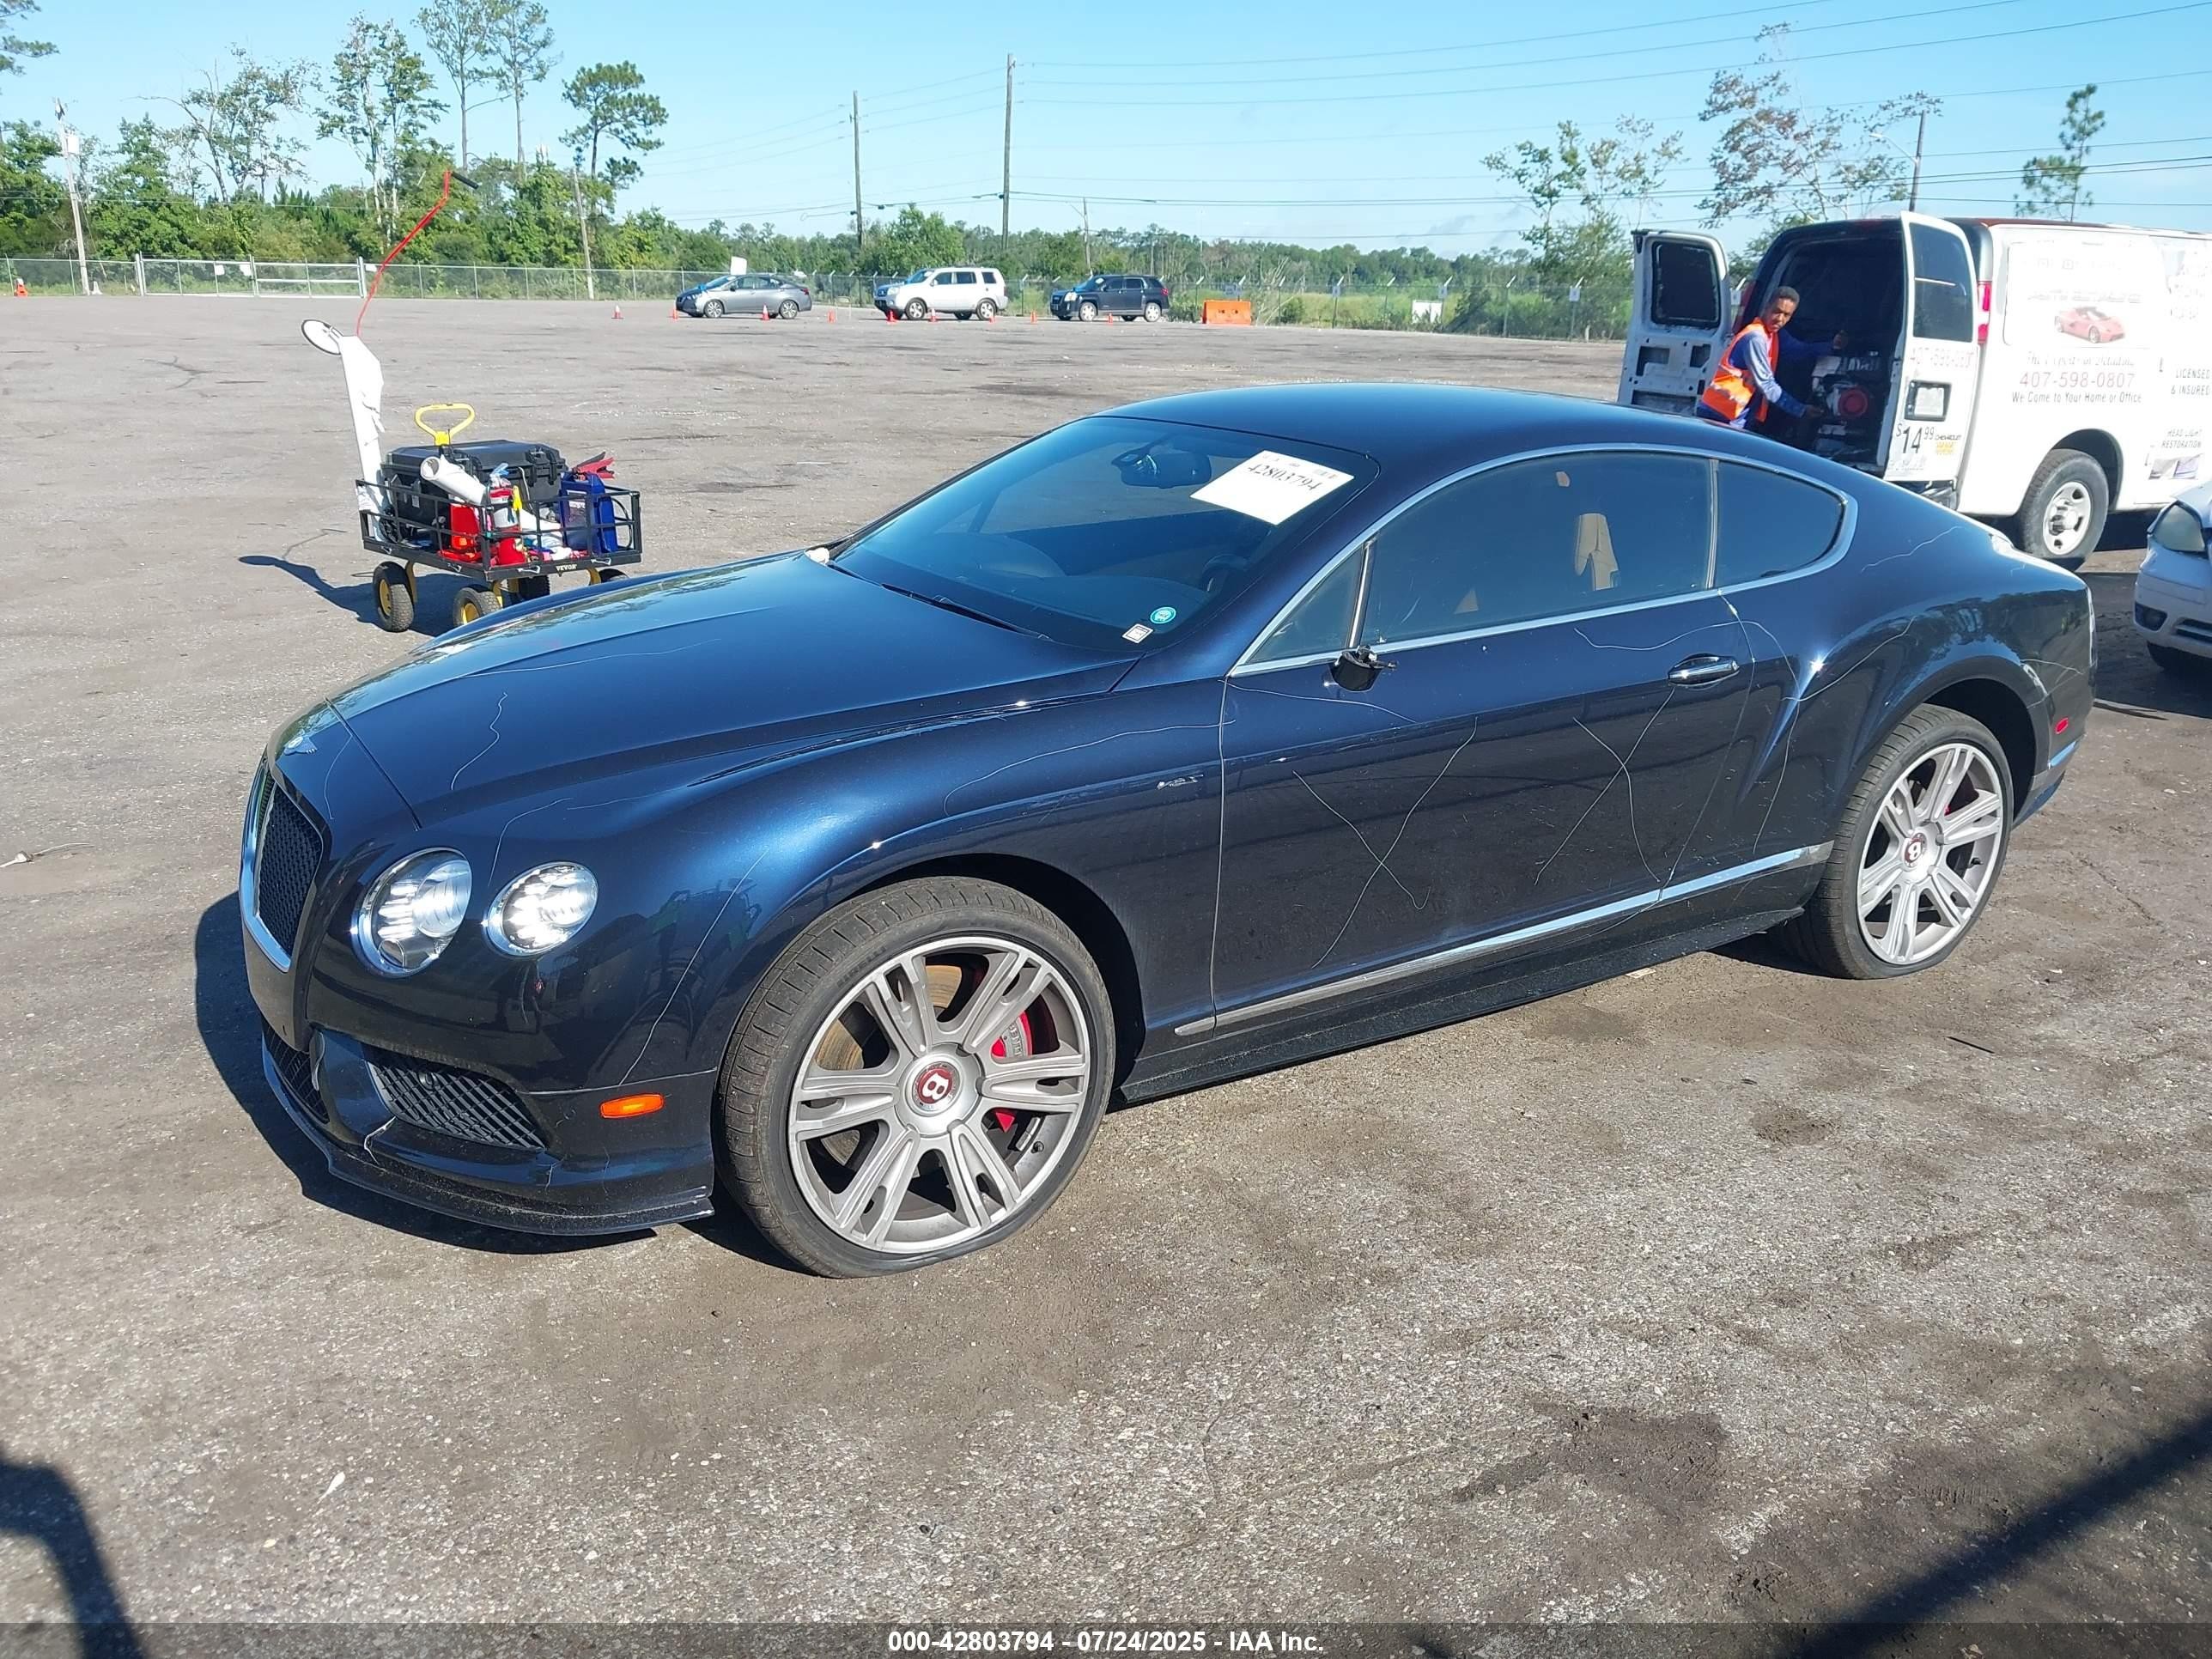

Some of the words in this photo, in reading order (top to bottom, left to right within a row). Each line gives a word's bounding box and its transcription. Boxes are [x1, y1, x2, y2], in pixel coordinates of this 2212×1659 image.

[2176, 368, 2211, 380] LICENSED
[2020, 371, 2136, 389] 407-598-0807
[2179, 386, 2211, 396] INSURED
[2012, 392, 2025, 403] We
[2028, 392, 2051, 403] Come
[2054, 392, 2062, 403] to
[2065, 392, 2081, 403] Your
[2085, 392, 2106, 403] Home
[2119, 392, 2142, 403] Office
[2161, 440, 2203, 449] RESTORATION
[1248, 463, 1323, 491] 42803794
